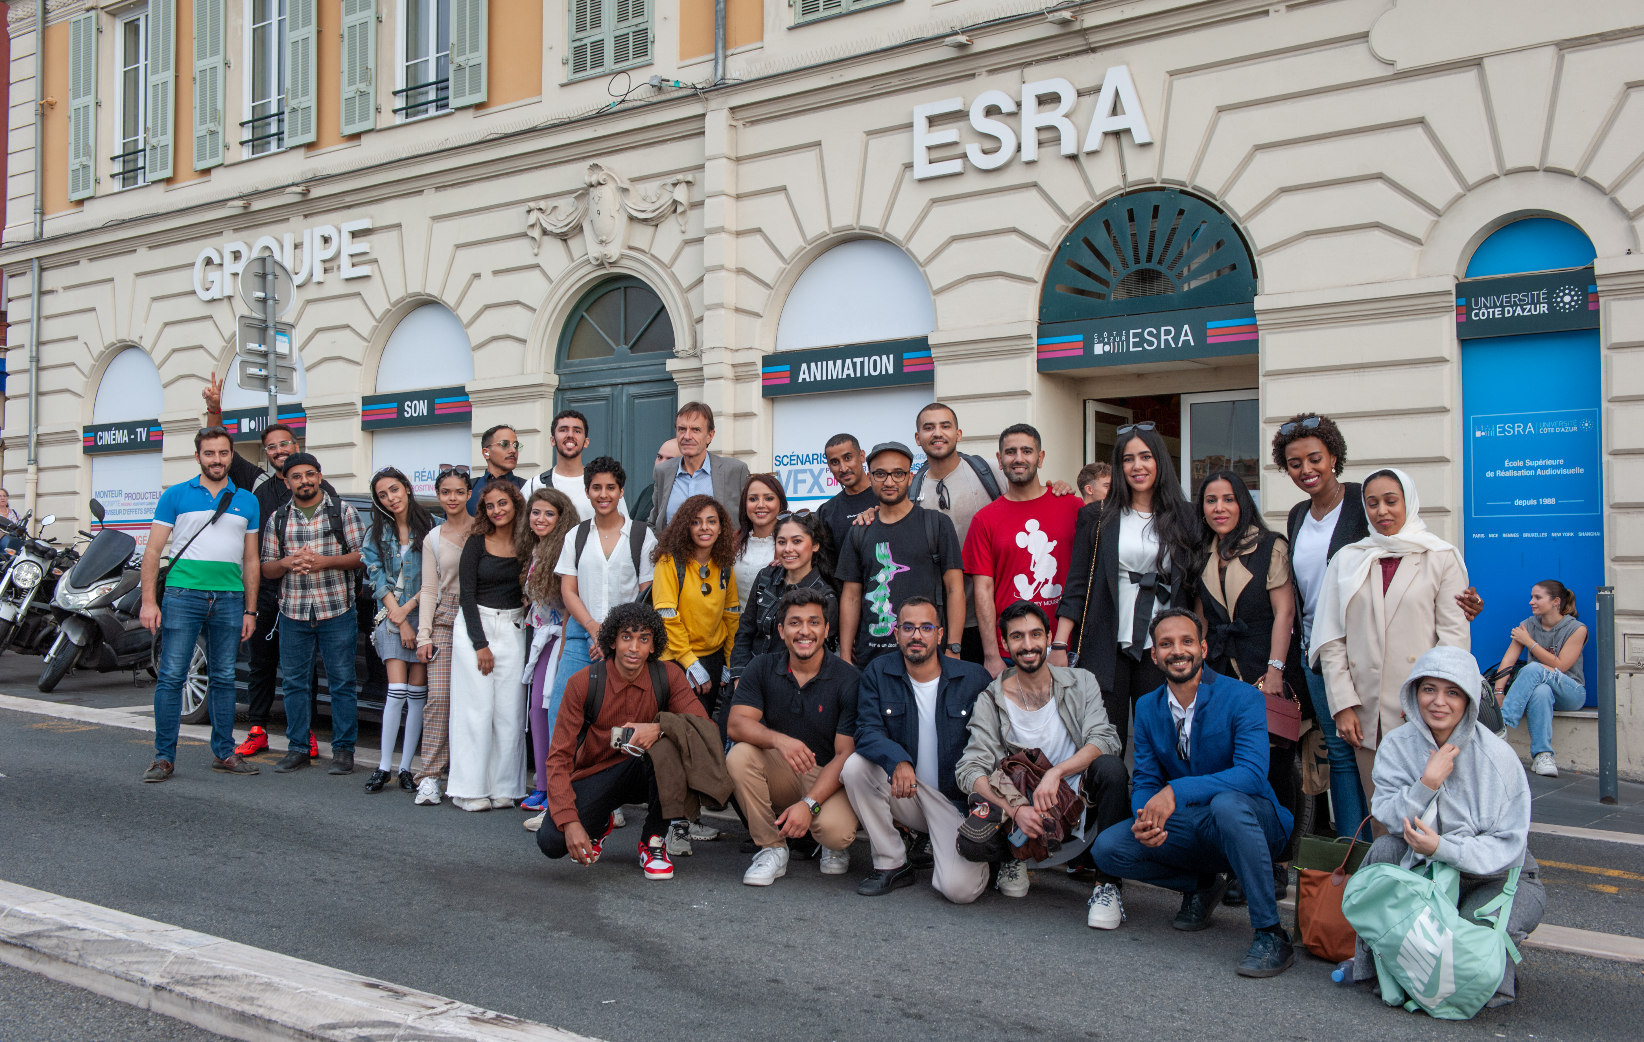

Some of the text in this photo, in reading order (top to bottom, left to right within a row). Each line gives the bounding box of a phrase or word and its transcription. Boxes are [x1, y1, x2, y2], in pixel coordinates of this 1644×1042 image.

[913, 65, 1153, 180] ESRA
[1472, 288, 1548, 308] UNIVERSITÉ
[1471, 304, 1549, 320] CÔTE D'AZUR
[1129, 324, 1195, 352] ESRA
[798, 354, 894, 383] ANIMATION
[404, 400, 428, 418] SON
[97, 428, 129, 445] CINÉMA
[136, 428, 147, 441] TV
[1496, 423, 1535, 436] ESRA
[1504, 458, 1564, 467] École Supérieure
[775, 467, 826, 495] VFX
[1485, 467, 1585, 478] de Réalisation Audiovisuelle
[94, 489, 123, 499] MONTEUR
[1514, 498, 1538, 507] depuis
[1396, 905, 1447, 994] NIKE
